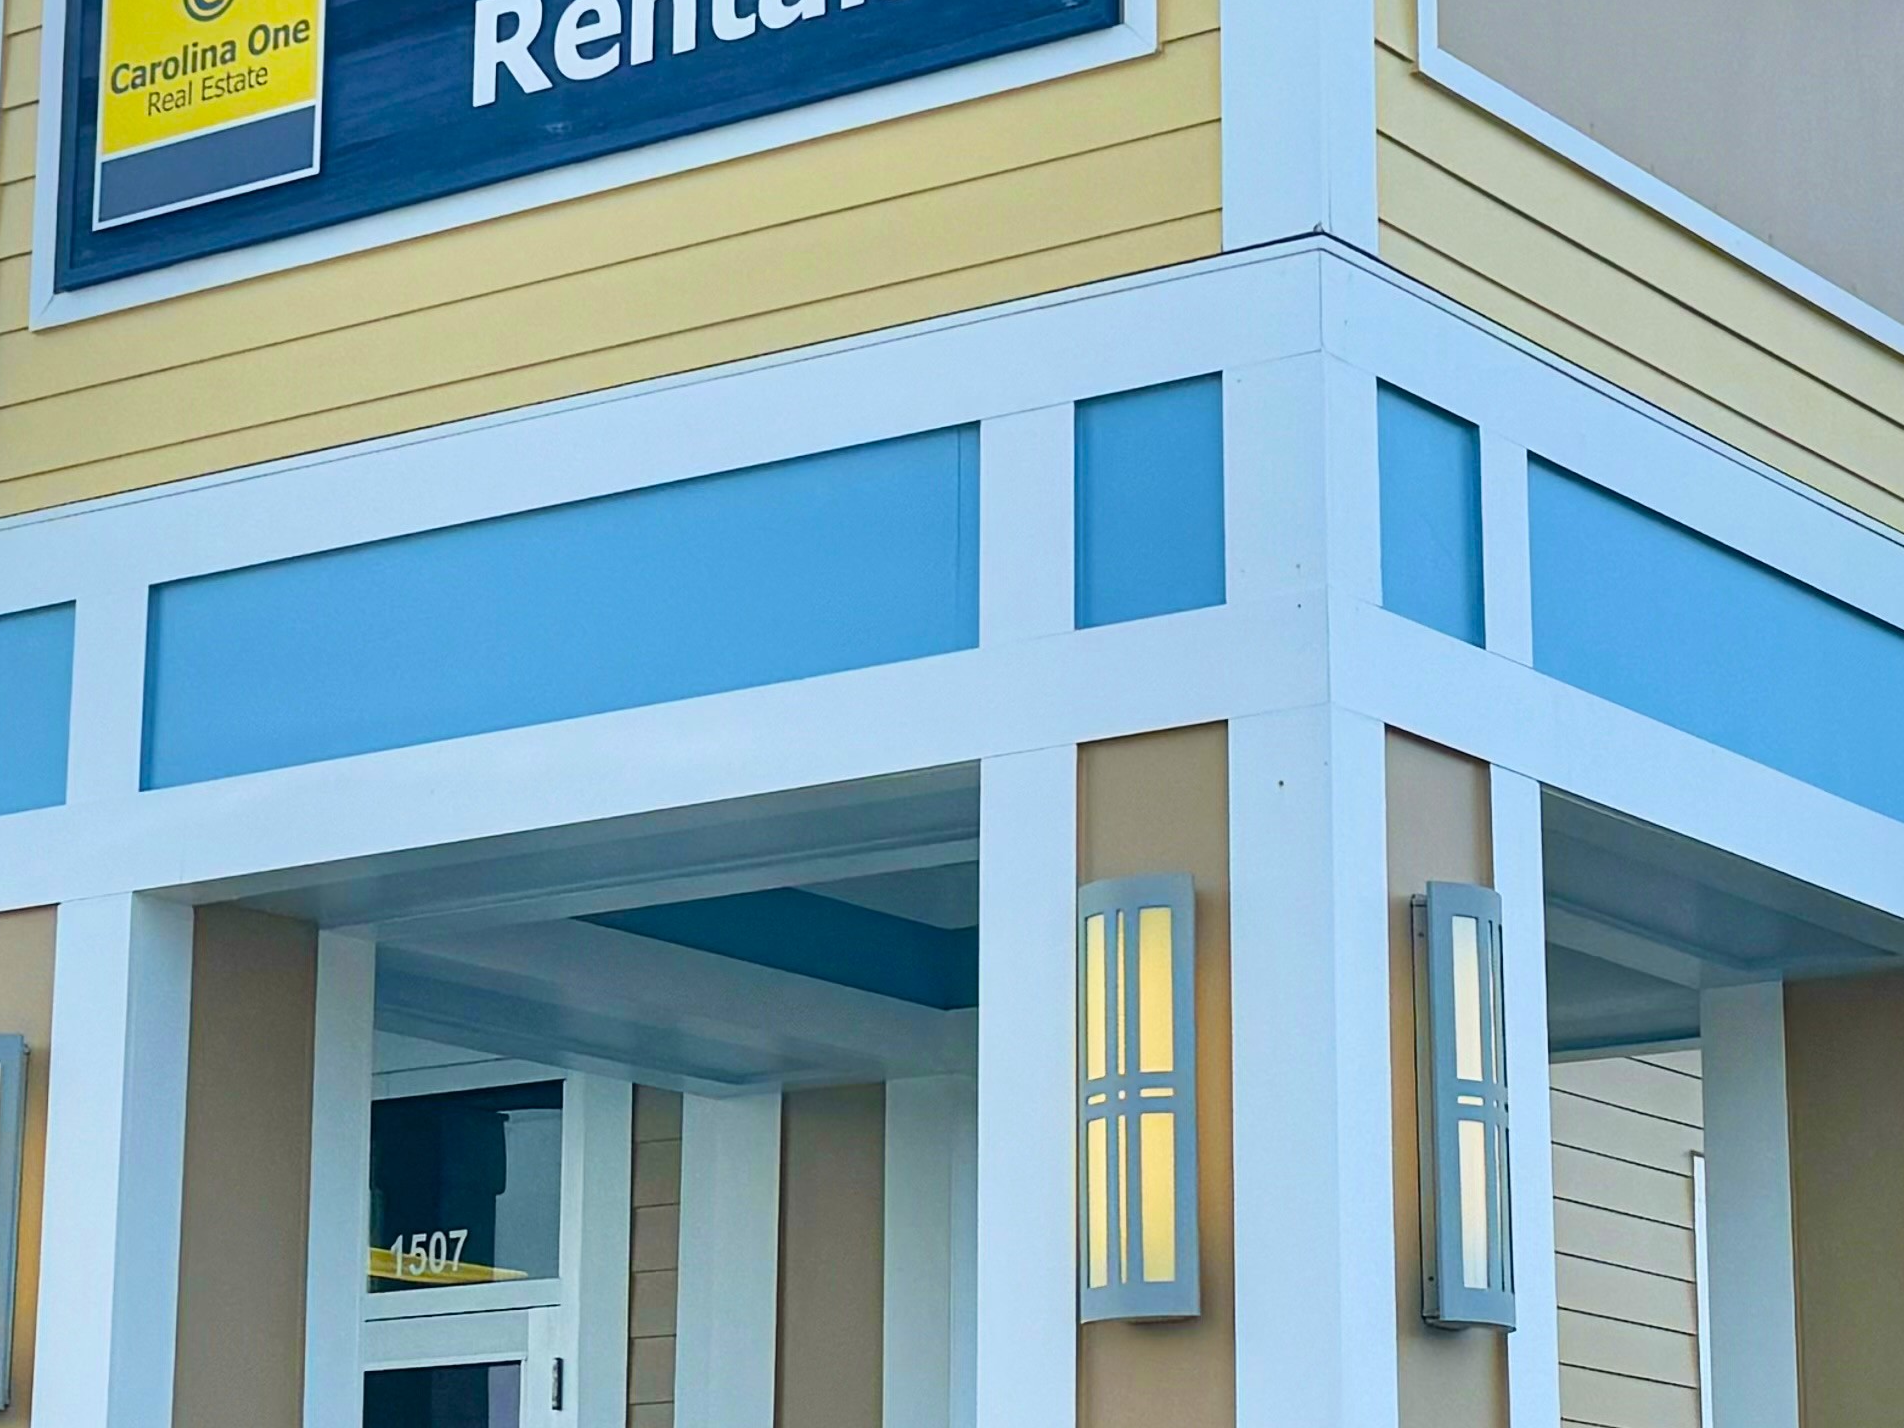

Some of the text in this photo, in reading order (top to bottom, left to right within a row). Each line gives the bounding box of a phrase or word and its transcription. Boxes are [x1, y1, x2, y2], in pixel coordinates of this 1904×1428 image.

[110, 19, 311, 95] Carolina One
[147, 66, 269, 117] Real Estate
[390, 1229, 469, 1277] 1507
